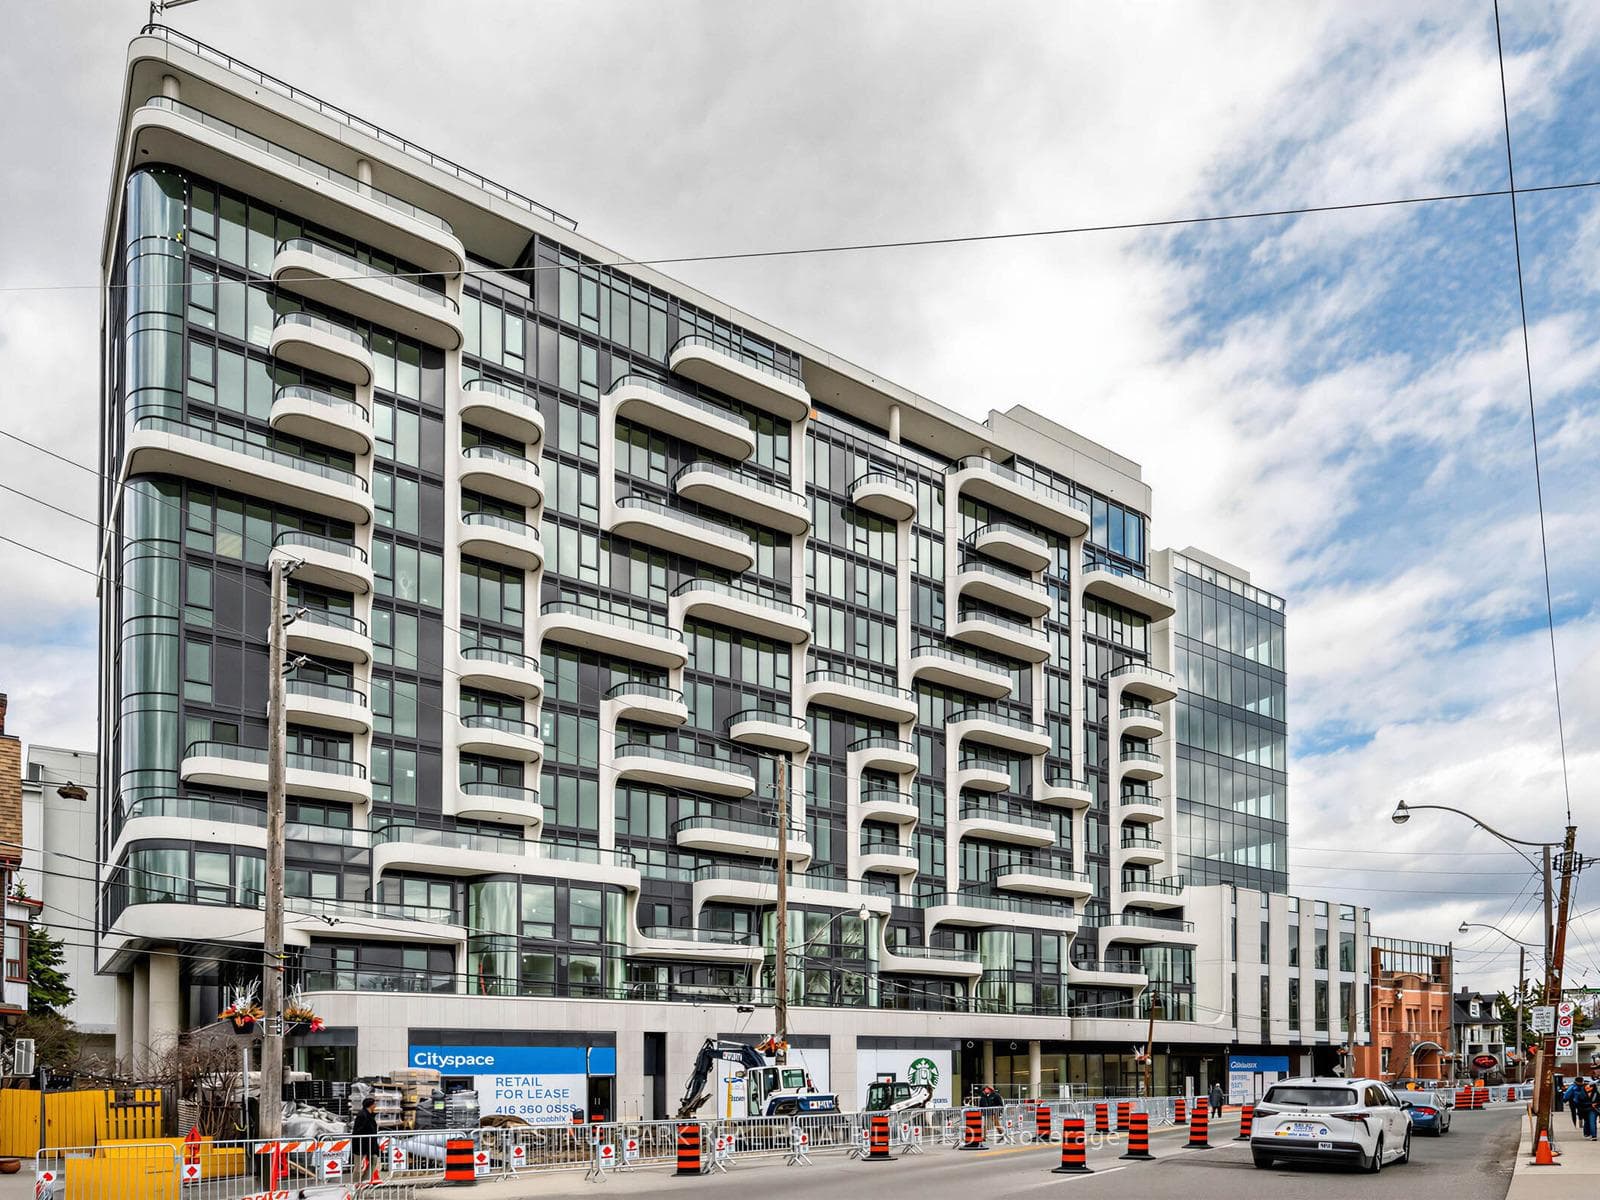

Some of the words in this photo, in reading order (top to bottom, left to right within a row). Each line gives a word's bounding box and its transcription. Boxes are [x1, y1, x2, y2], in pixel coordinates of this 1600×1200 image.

[415, 1052, 495, 1068] Cityspace
[495, 1077, 543, 1087] RETAIL
[495, 1089, 523, 1099] FOR
[527, 1089, 570, 1099] LEASE
[495, 1105, 516, 1115] 416
[519, 1104, 543, 1114] 360
